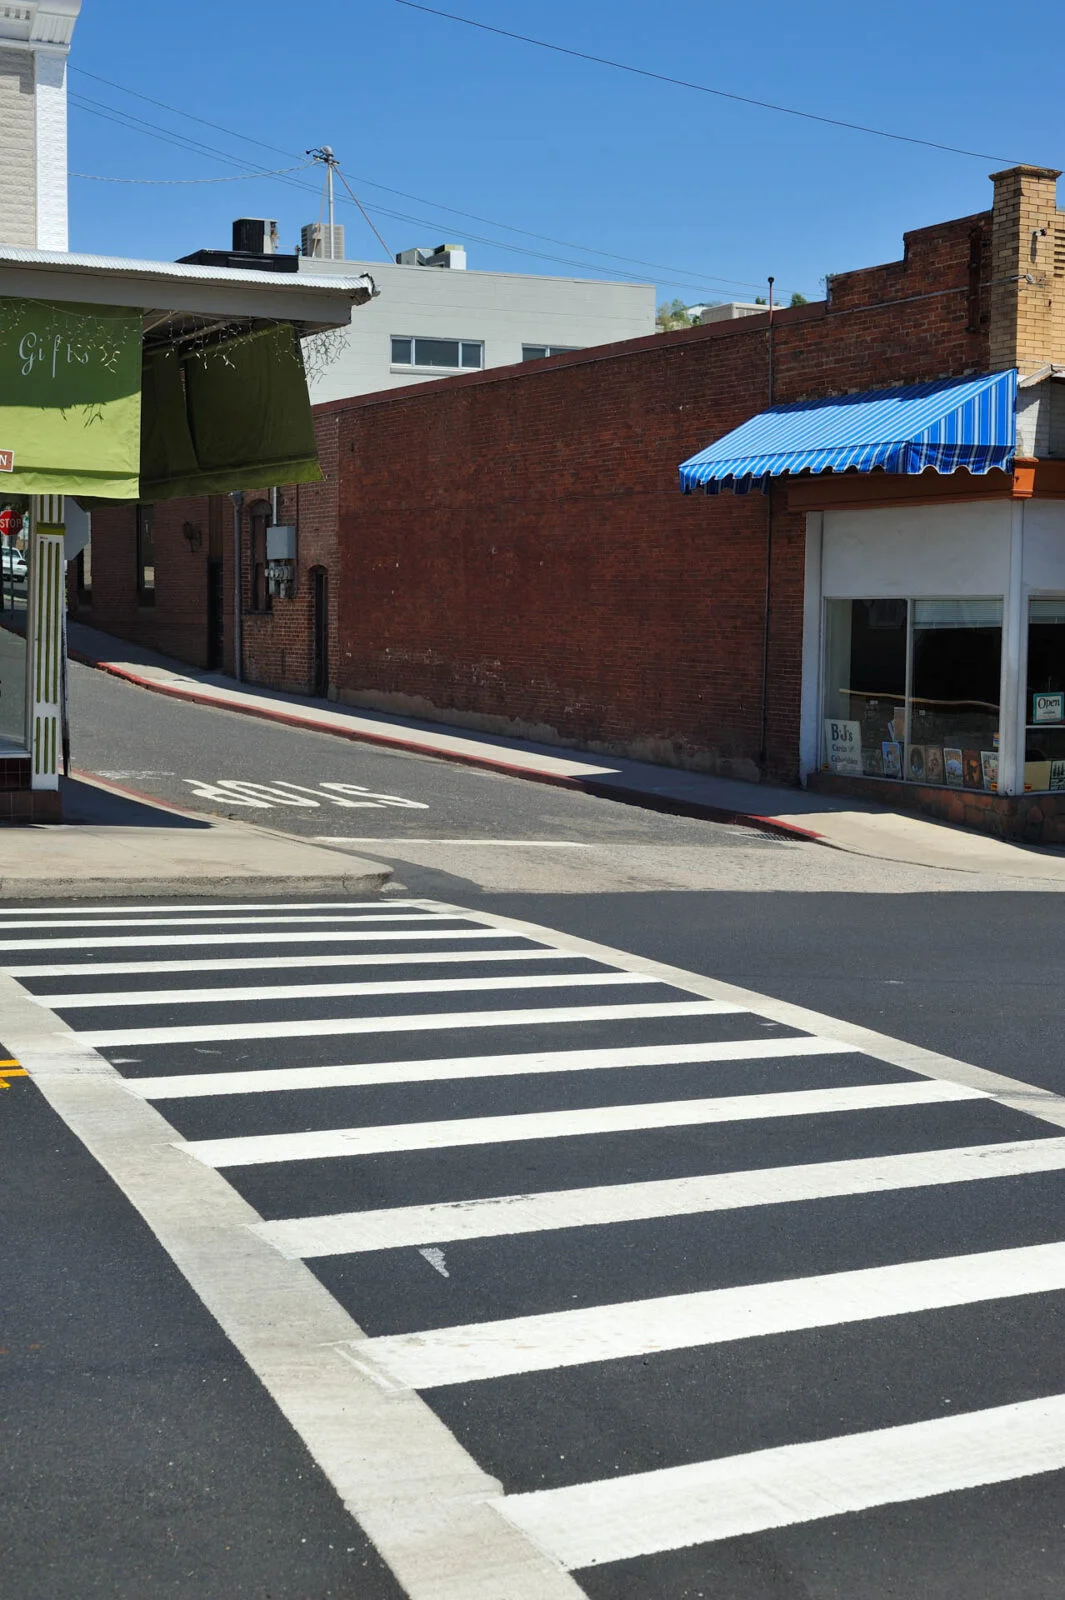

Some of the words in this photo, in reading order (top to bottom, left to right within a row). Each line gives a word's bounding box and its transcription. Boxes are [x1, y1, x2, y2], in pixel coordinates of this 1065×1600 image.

[19, 331, 89, 379] Gifts
[0, 518, 22, 529] STOP
[1037, 697, 1060, 710] Open
[182, 779, 430, 809] STOP
